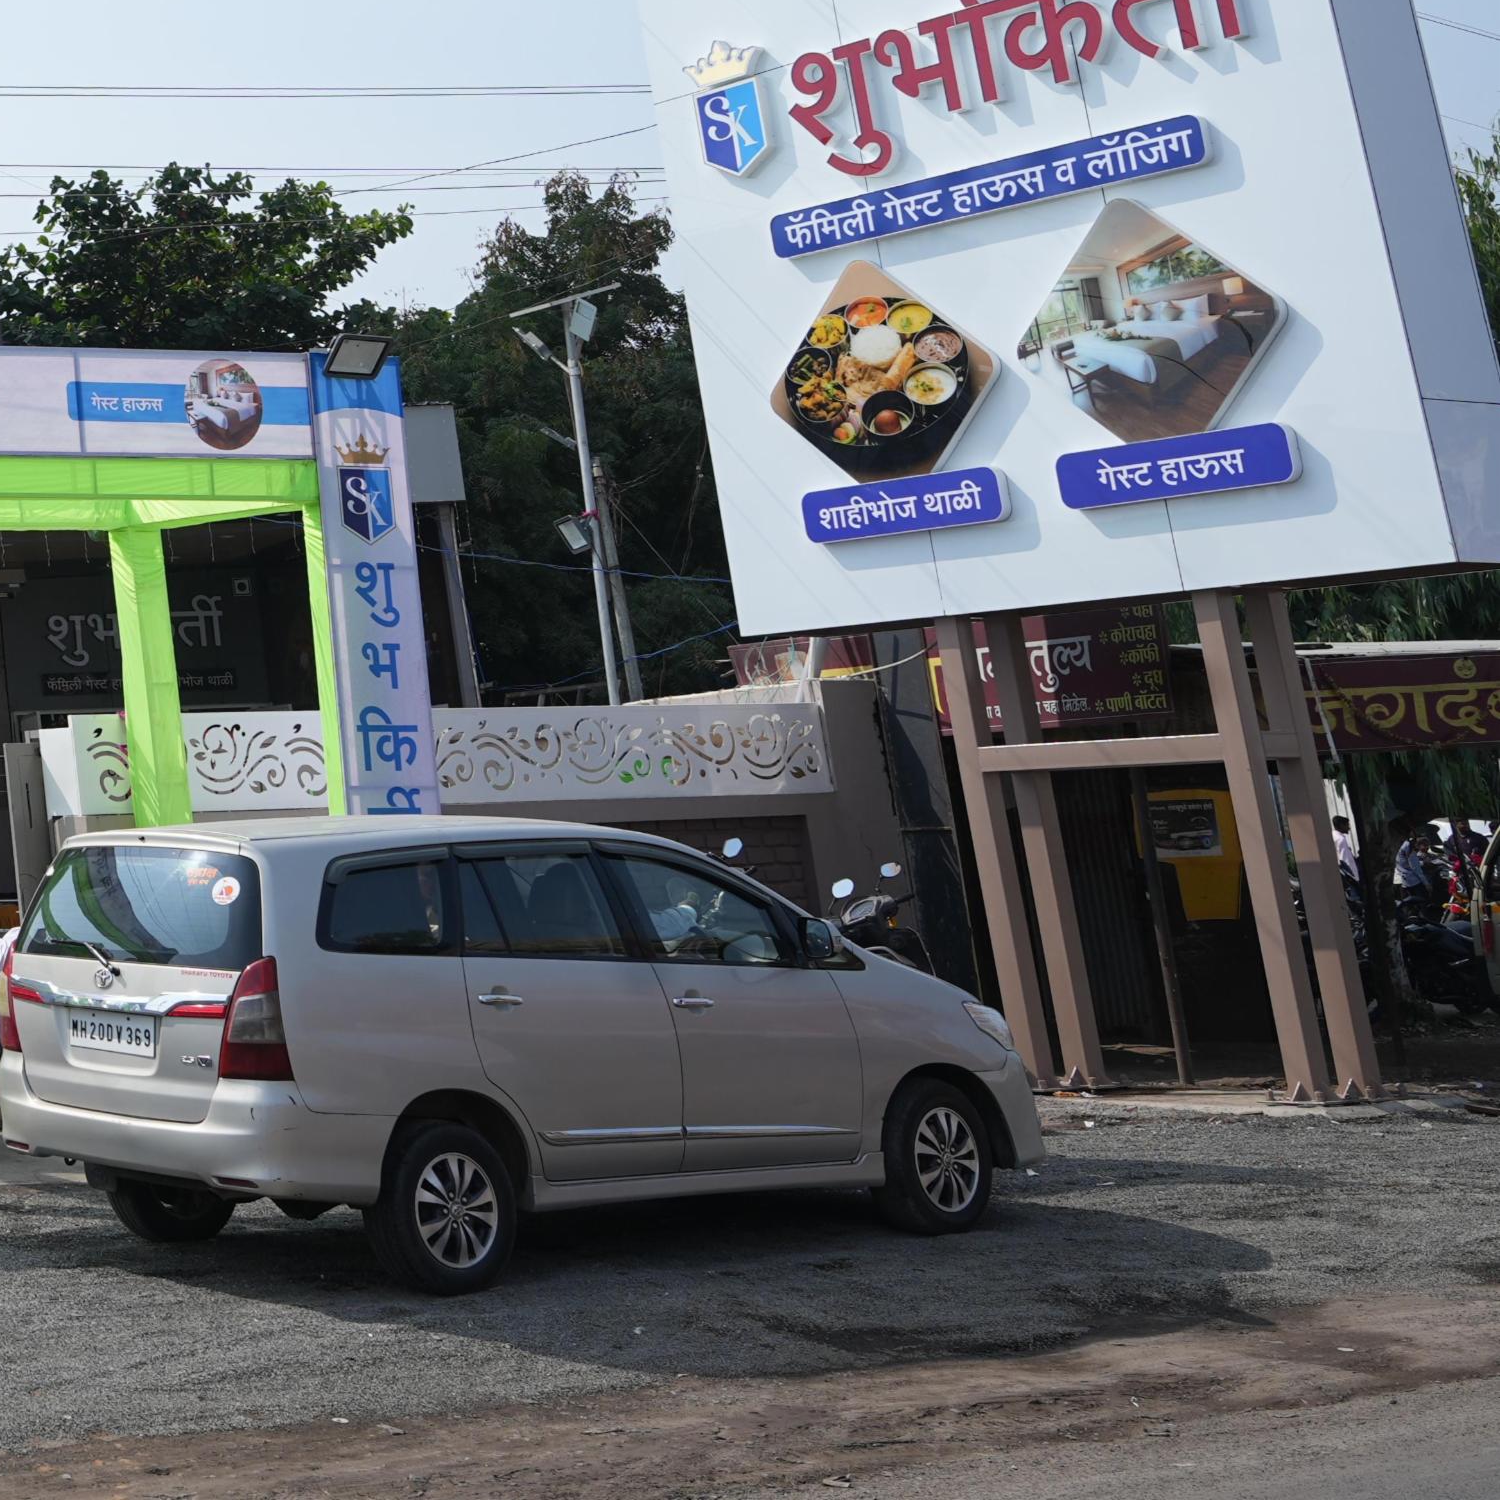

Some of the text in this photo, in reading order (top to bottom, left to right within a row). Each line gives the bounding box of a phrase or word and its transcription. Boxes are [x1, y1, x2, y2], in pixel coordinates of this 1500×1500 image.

[785, 122, 1194, 252] फॅमिली गेस्ट हाऊस व लॉजिंग
[90, 392, 164, 413] गेस्ट हाऊस
[1096, 446, 1245, 494] गेस्ट हाऊस
[817, 482, 982, 533] शाहीभोज थाळी
